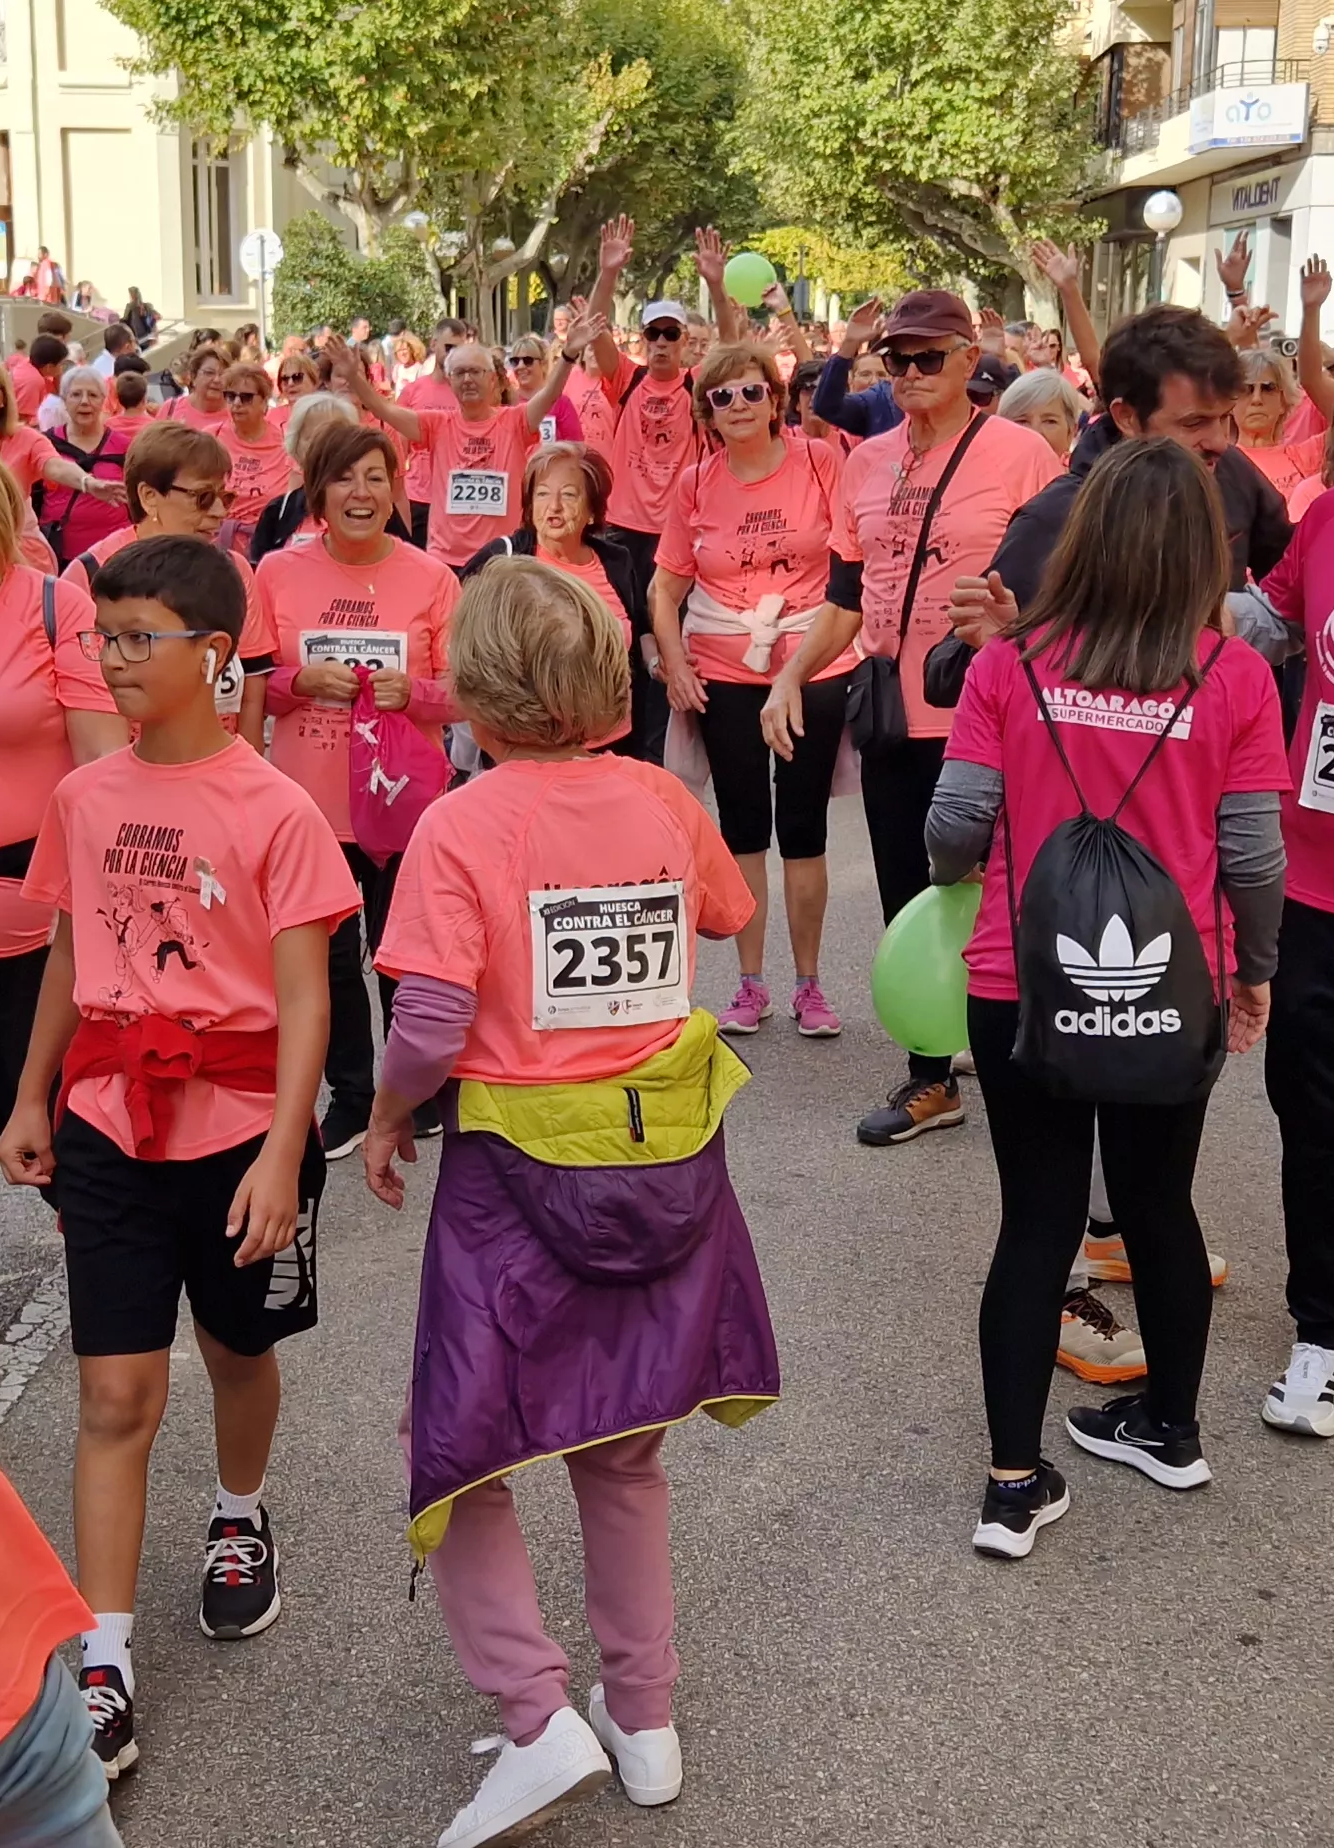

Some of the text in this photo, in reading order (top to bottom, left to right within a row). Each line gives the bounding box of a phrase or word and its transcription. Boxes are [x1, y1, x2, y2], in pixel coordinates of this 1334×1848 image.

[452, 484, 502, 503] 2298
[310, 641, 396, 655] CONTRA EL CÁNCER
[115, 822, 185, 854] CORRAMOS
[102, 847, 189, 882] POR LA CIENCIA
[552, 908, 674, 931] CONTRA EL CÁNCER
[598, 900, 641, 914] HUESCA
[551, 930, 675, 990] 2357
[1054, 1006, 1182, 1037] adidas
